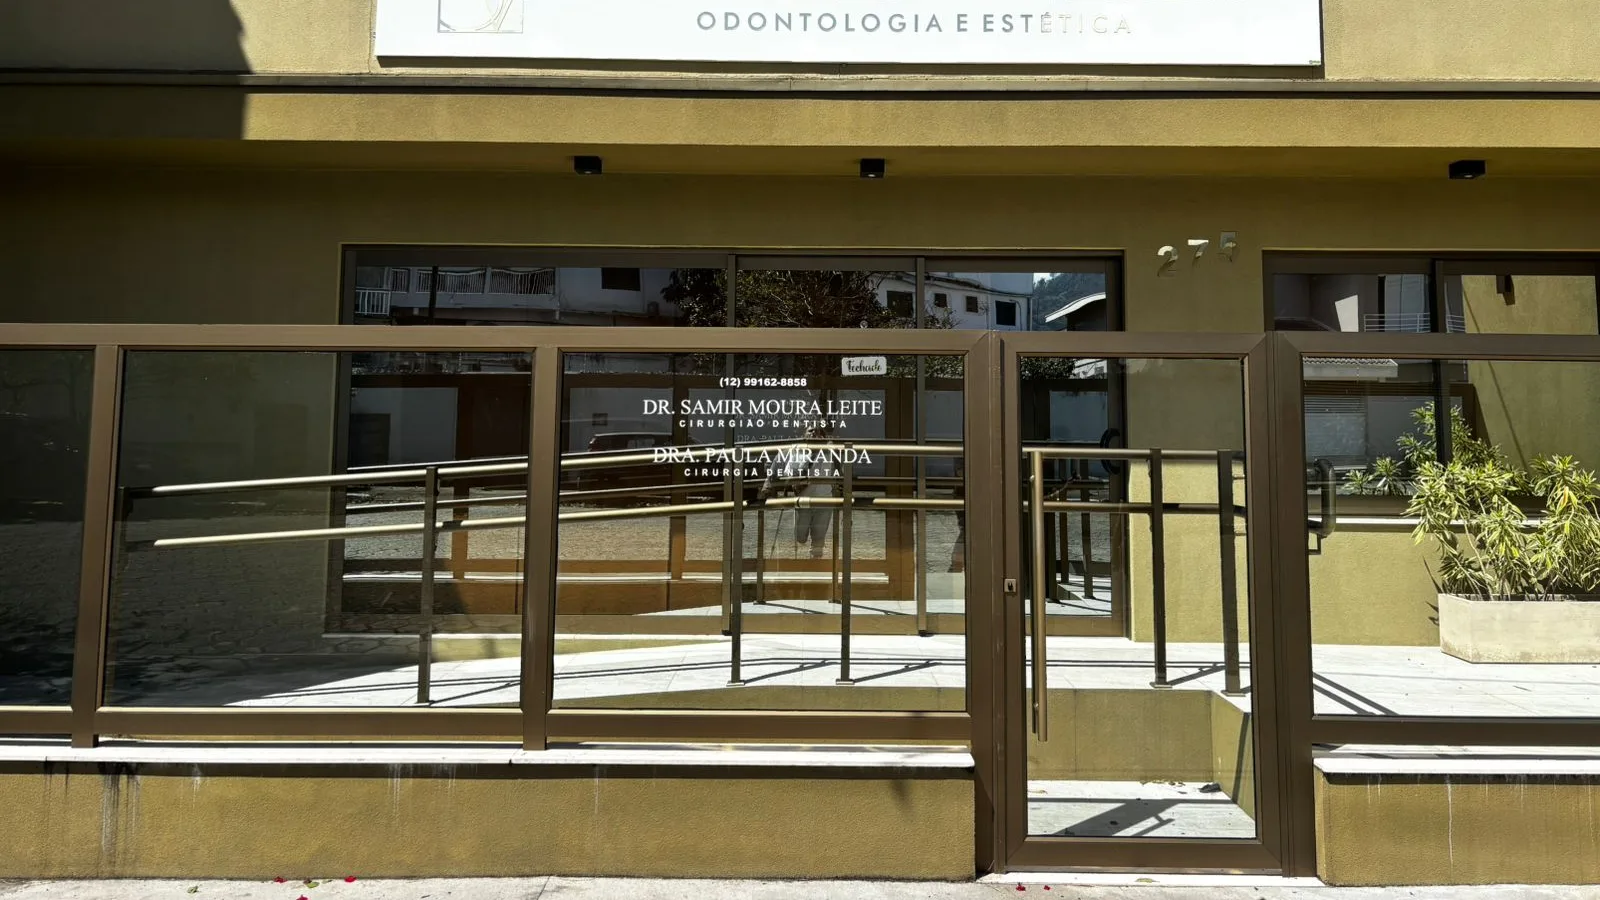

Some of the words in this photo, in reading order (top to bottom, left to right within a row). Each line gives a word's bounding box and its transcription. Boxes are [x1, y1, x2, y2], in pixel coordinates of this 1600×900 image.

[697, 11, 943, 33] ODONTOLOGIA
[957, 13, 968, 32] E
[983, 12, 1131, 33] ESTÉTICA
[1157, 231, 1237, 276] 275
[719, 377, 741, 388] (12)
[744, 377, 807, 387] 99162-8858
[643, 399, 675, 415] DR.
[681, 399, 744, 415] SAMIR
[749, 399, 822, 415] MOURA
[827, 399, 883, 415] LEITE
[773, 419, 847, 428] DENTISTA
[653, 447, 700, 463] DRA.
[705, 447, 772, 463] PAULA
[776, 448, 872, 463] MIRANDA
[766, 468, 841, 477] DENTISTA
